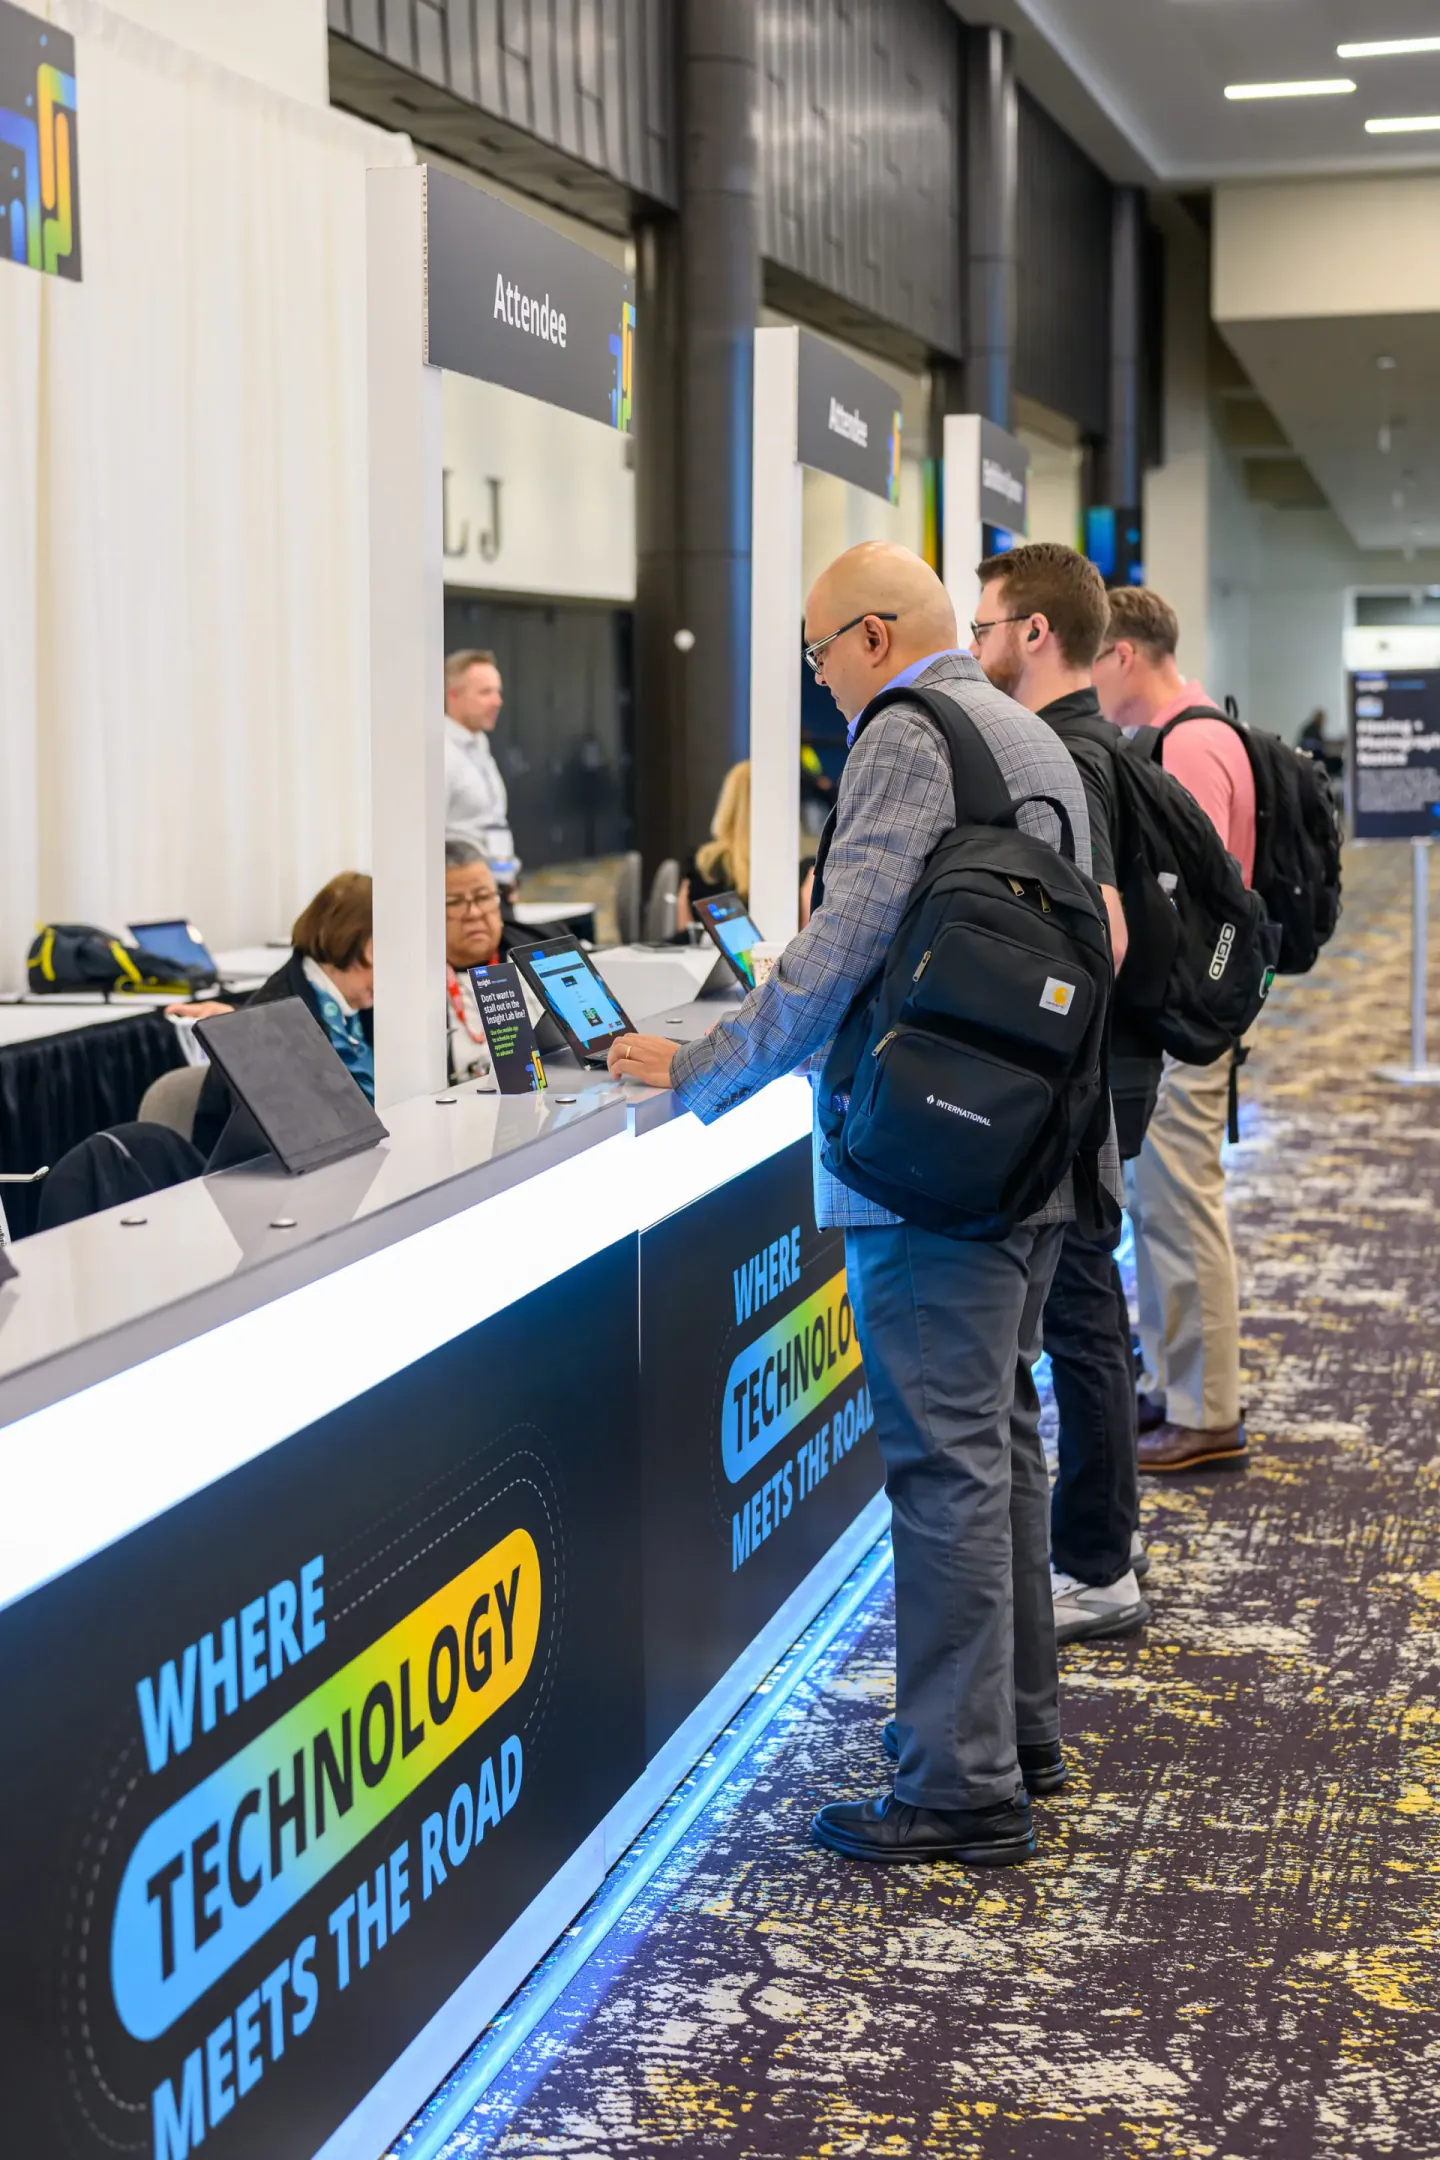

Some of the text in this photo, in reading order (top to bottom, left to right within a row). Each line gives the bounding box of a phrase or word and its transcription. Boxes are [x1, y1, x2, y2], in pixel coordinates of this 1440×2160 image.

[493, 272, 567, 348] Attendee
[1209, 923, 1236, 980] OGIO
[481, 992, 497, 1003] Don't
[496, 990, 509, 1001] want
[484, 1000, 520, 1014] stall out in the
[486, 1009, 526, 1026] Insight Lab line?
[936, 1099, 992, 1127] INTERNATIONAL
[733, 1225, 800, 1327] WHERE
[732, 1460, 793, 1573] MEETS
[796, 1422, 829, 1501] THE
[136, 1554, 326, 1775] WHERE
[147, 1564, 521, 1984] TECHNOLOGY
[152, 1735, 523, 2160] MEETS THE ROAD
